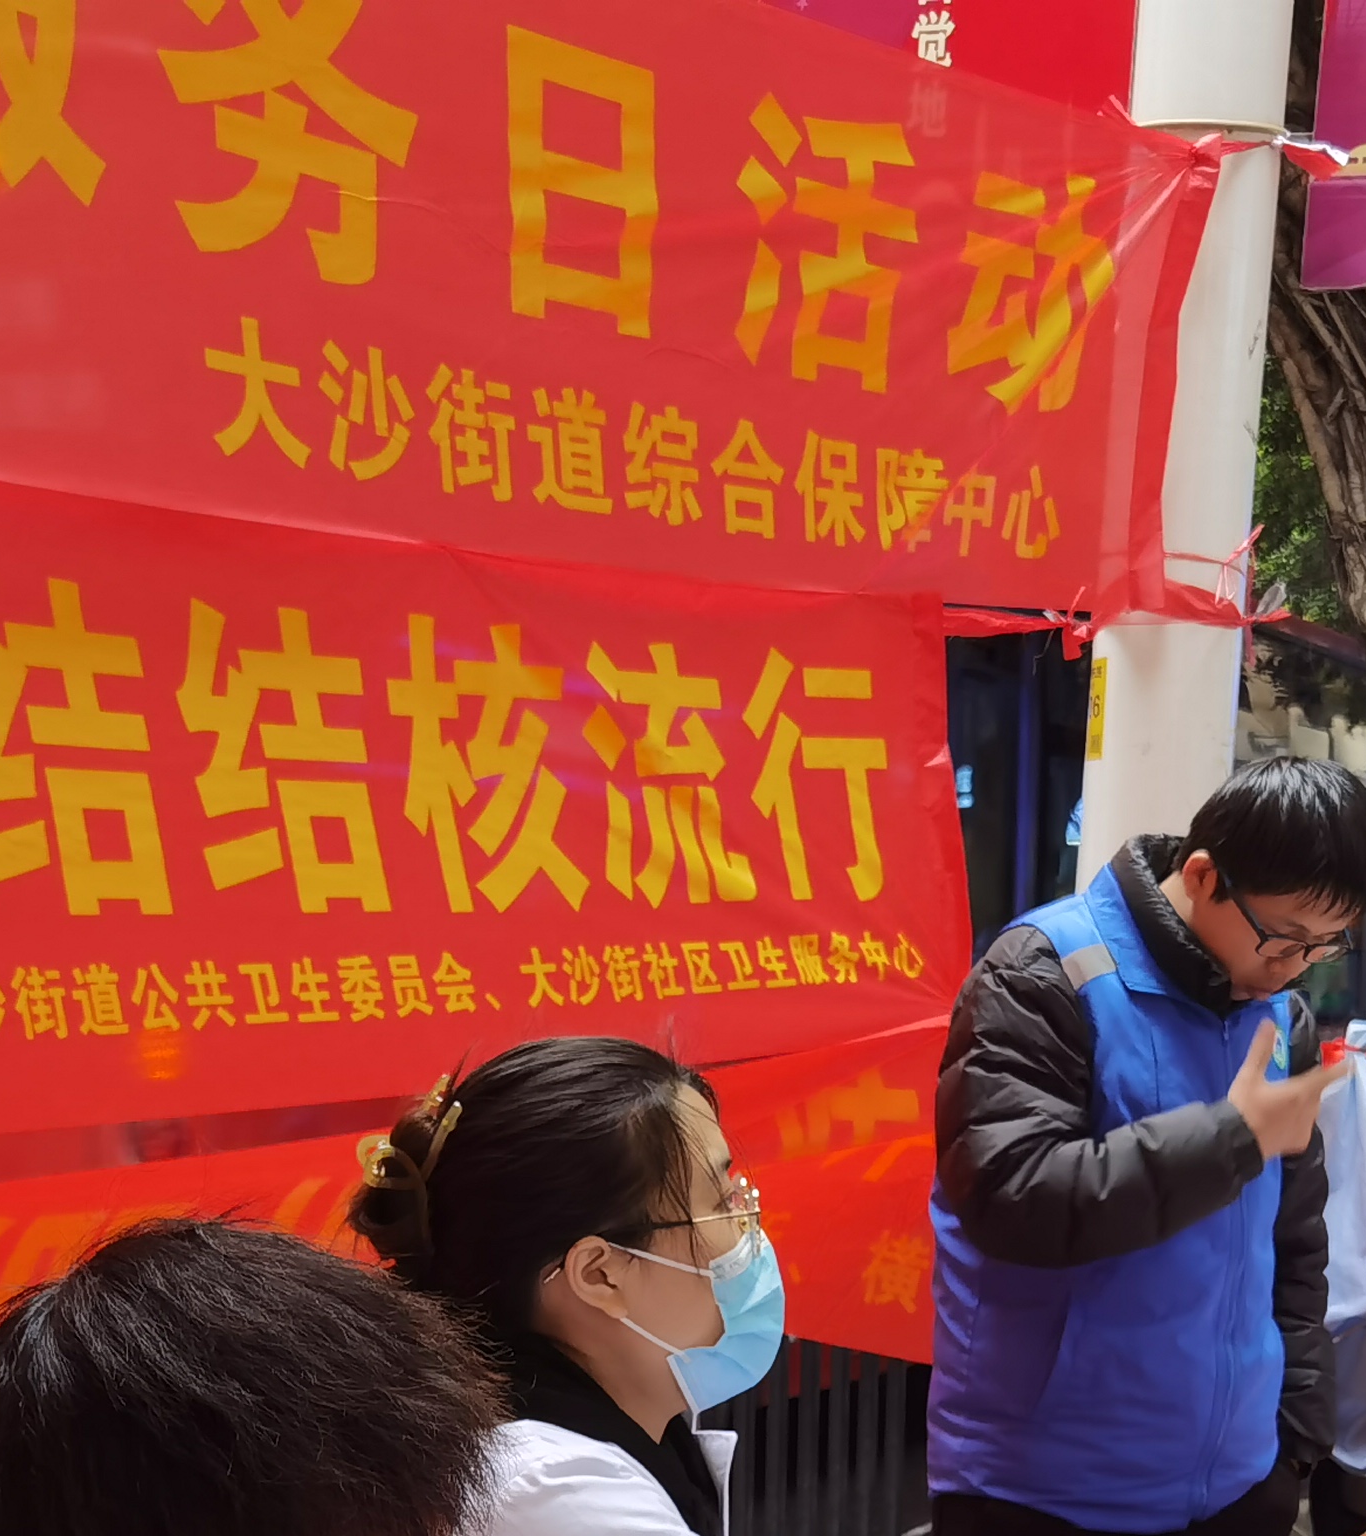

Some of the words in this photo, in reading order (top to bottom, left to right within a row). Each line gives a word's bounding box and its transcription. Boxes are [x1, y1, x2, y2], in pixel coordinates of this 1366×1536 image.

[204, 316, 1059, 559] 大沙街道综合保障中心
